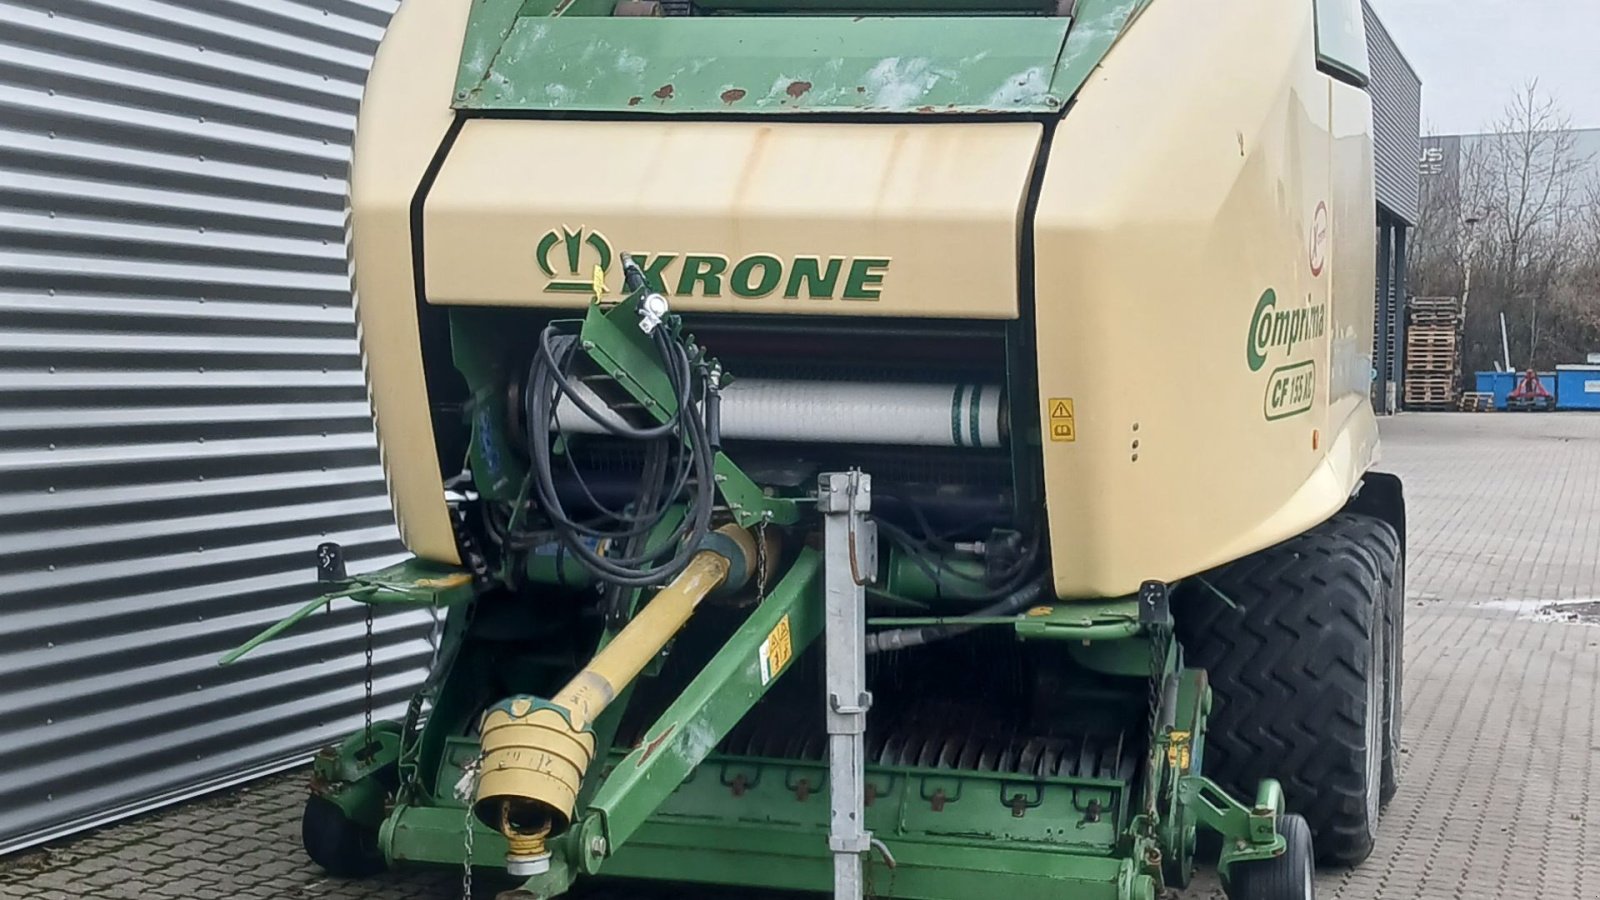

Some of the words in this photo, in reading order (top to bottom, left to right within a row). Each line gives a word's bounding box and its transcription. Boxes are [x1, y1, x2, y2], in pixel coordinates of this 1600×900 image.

[622, 252, 892, 301] KRONE
[1247, 288, 1325, 371] Comprima
[1272, 378, 1289, 408] CF
[1289, 374, 1304, 405] 155
